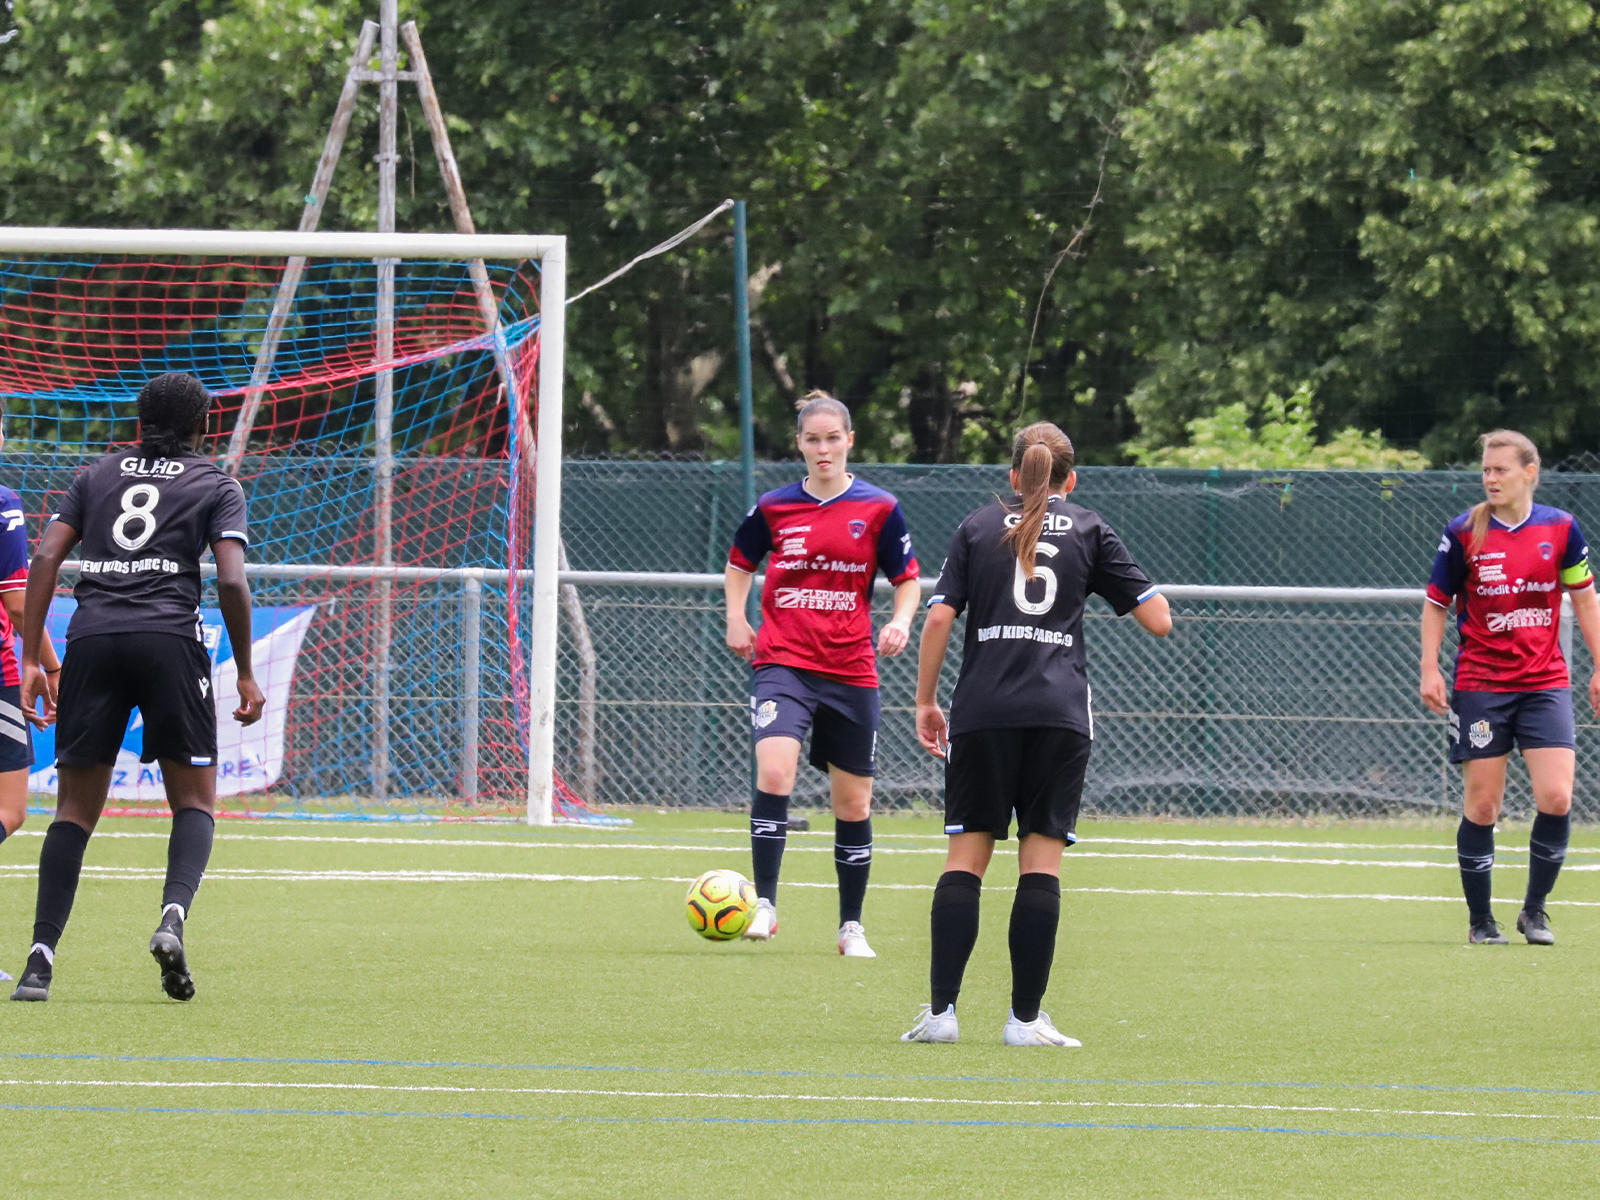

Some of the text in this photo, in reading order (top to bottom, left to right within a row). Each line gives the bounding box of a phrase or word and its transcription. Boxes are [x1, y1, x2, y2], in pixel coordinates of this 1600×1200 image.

[120, 457, 185, 475] GLHD
[112, 484, 160, 551] 8
[1004, 512, 1073, 531] GHD
[102, 559, 130, 574] KIDS
[131, 558, 160, 573] PARC
[162, 559, 179, 574] 89
[830, 560, 867, 573] Mutuel
[1013, 542, 1060, 615] 6
[1476, 584, 1510, 596] Crédit
[800, 599, 856, 611] FERRAND
[978, 625, 1001, 642] NEW
[1002, 625, 1033, 639] KIDS
